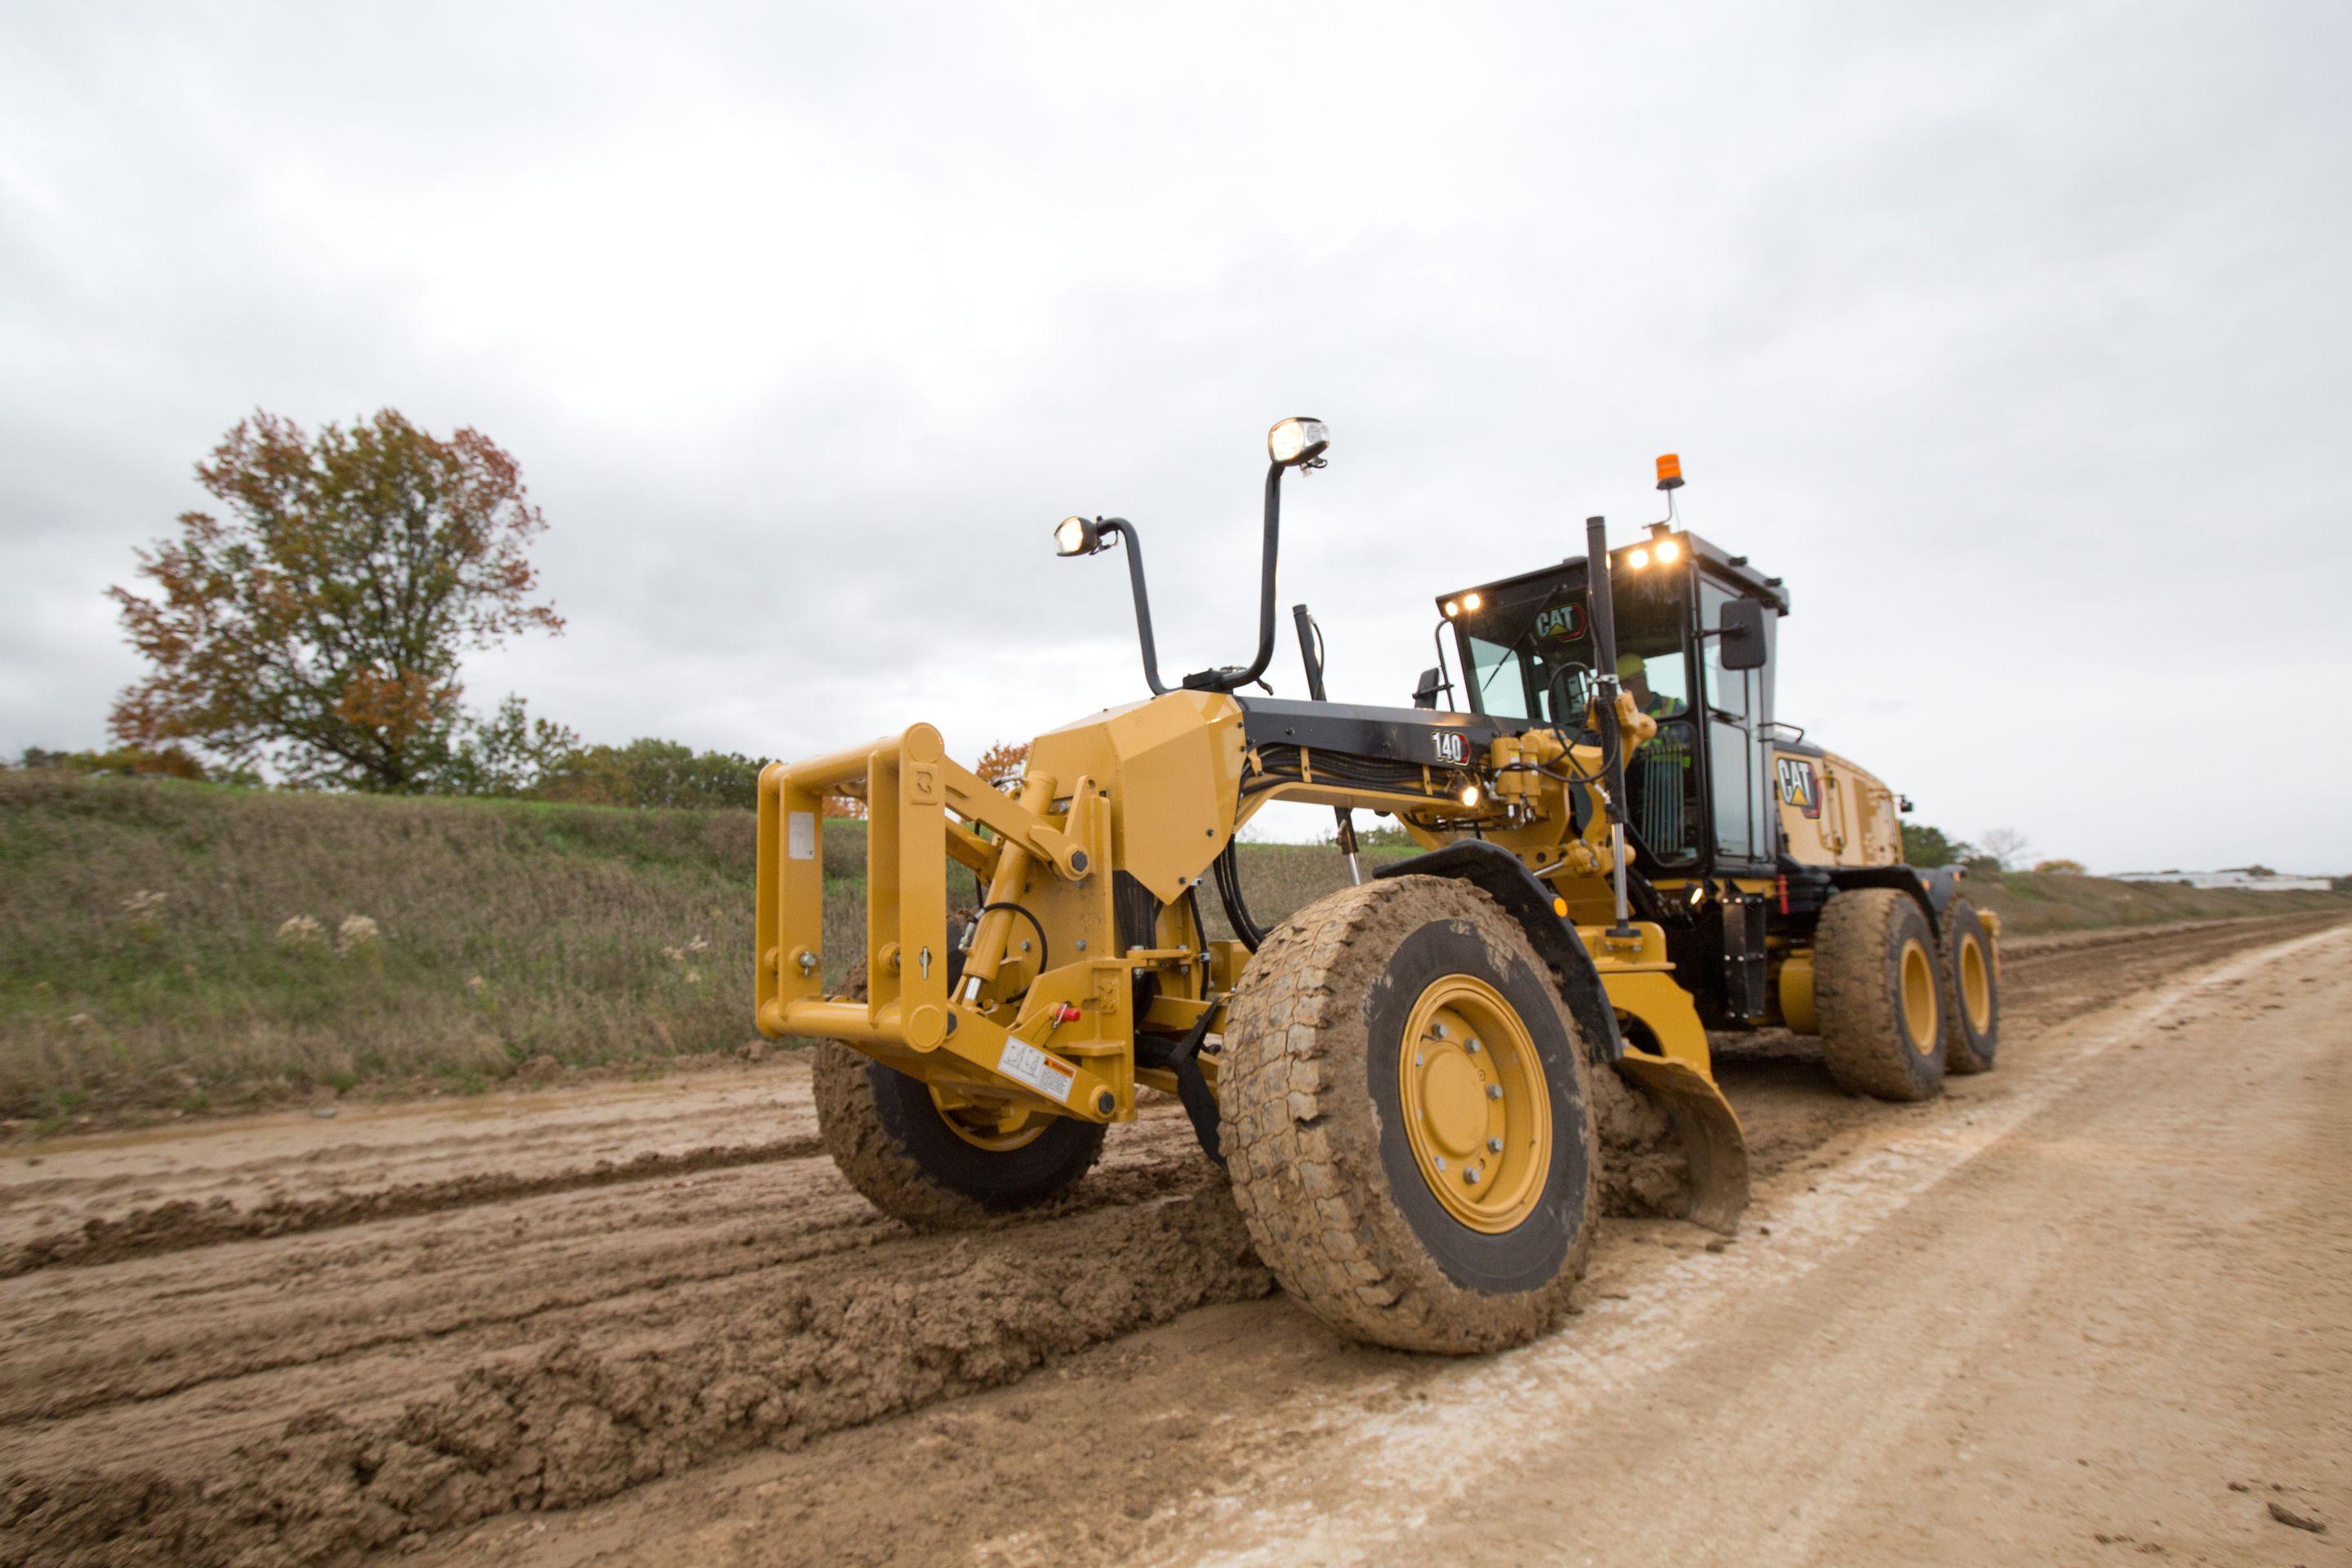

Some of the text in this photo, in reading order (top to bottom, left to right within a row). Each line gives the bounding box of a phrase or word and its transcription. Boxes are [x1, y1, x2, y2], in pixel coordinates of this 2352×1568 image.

[1536, 606, 1573, 637] CAT
[1432, 731, 1462, 761] 140
[1778, 759, 1812, 804] CAT
